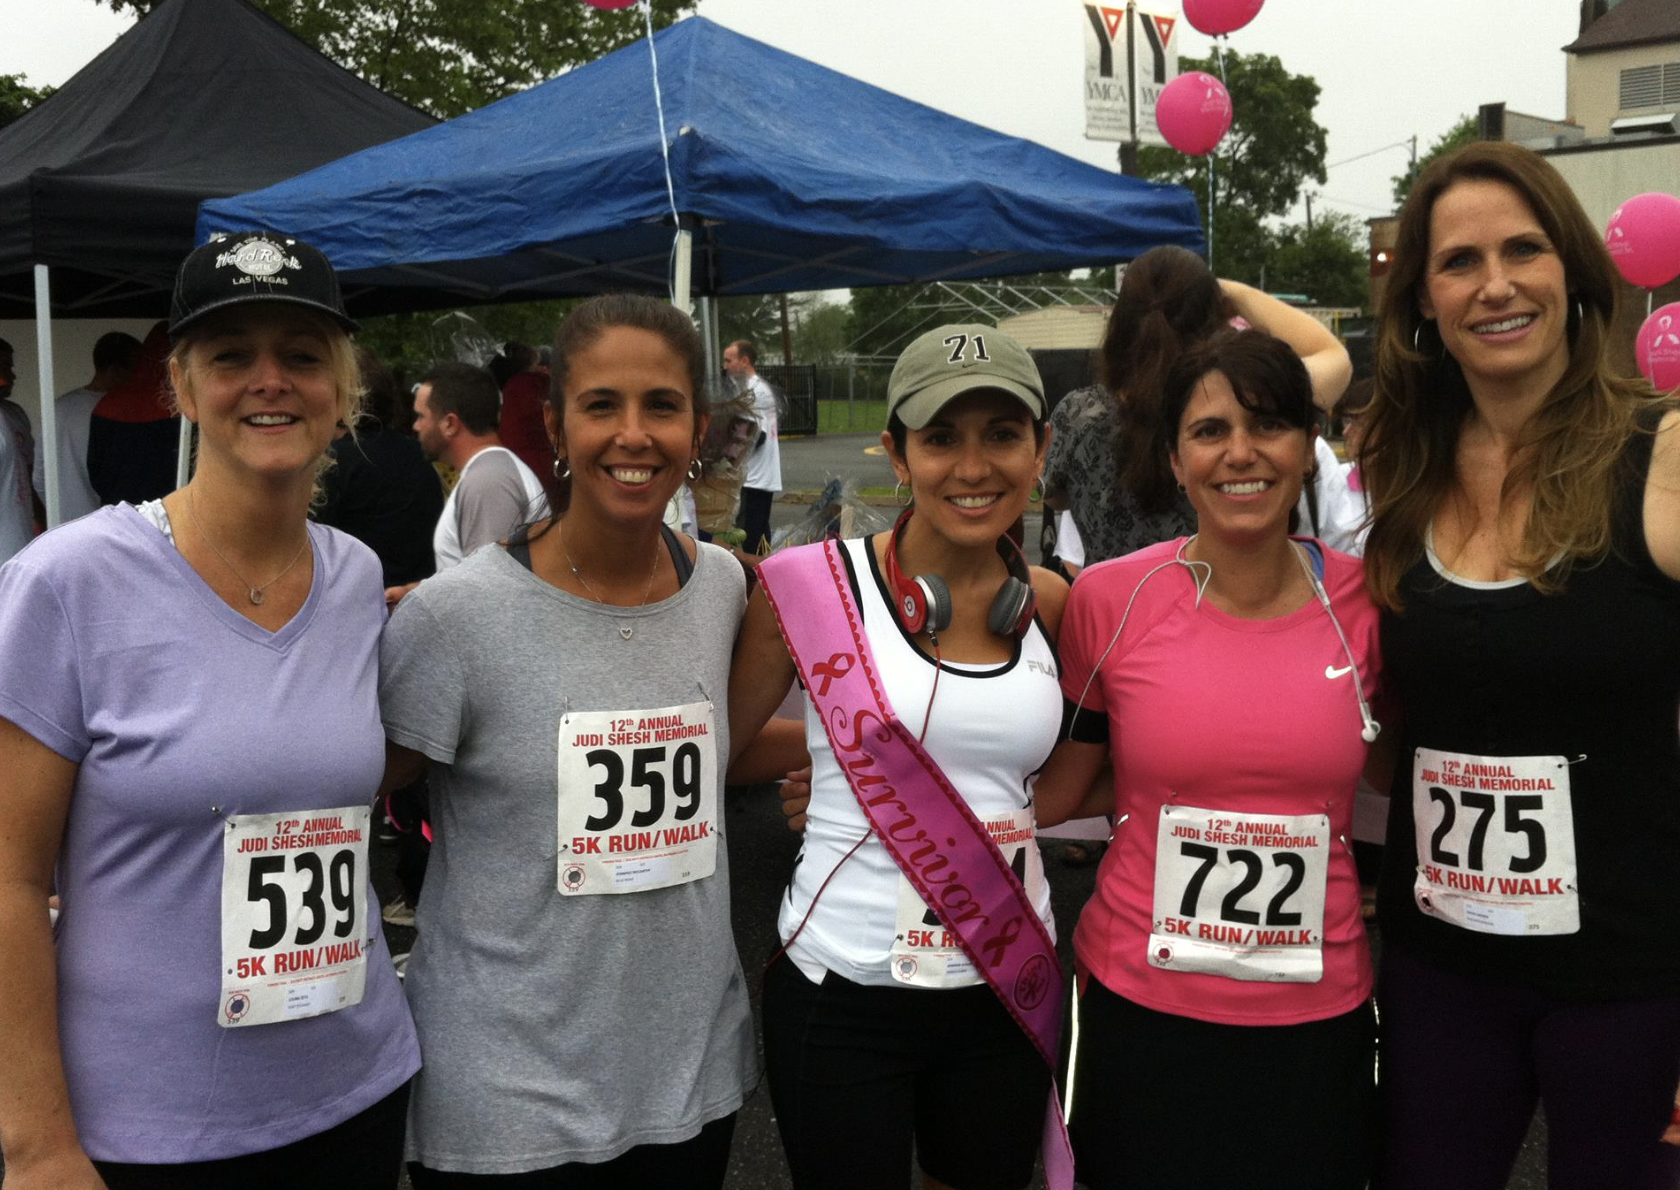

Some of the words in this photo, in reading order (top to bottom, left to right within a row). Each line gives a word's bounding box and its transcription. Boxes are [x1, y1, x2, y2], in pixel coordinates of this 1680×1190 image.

[1086, 81, 1127, 103] YMCA
[215, 249, 257, 269] Hard
[260, 248, 302, 270] Rock
[232, 276, 251, 285] LAS
[254, 275, 289, 285] VEGAS
[943, 333, 991, 364] 71
[1027, 660, 1055, 678] FILA
[610, 718, 634, 732] 12th
[638, 715, 684, 731] ANNUAL
[572, 734, 604, 747] JUDI
[608, 731, 651, 745] SHESH
[655, 723, 708, 743] MEMORIAL
[1421, 769, 1439, 783] JUDI
[1442, 773, 1475, 789] SHESH
[1479, 778, 1556, 791] MEMORIAL
[1442, 760, 1461, 773] 12th
[1464, 763, 1515, 778] ANNUAL
[584, 742, 701, 831] 359
[276, 819, 299, 834] 12th
[302, 817, 343, 833] ANNUAL
[831, 706, 990, 929] Survivor
[1207, 819, 1231, 831] 12th
[1235, 822, 1288, 836] ANNUAL
[1171, 826, 1199, 839] JUDI
[1204, 831, 1248, 845] SHESH
[1252, 836, 1318, 848] MEMORIAL
[1429, 787, 1547, 873] 275
[237, 837, 268, 853] JUDI
[271, 832, 314, 850] SHESH
[572, 836, 601, 855] 5K
[1180, 841, 1305, 926] 722
[1425, 865, 1443, 885] 5K
[247, 849, 355, 949] 539
[1165, 917, 1191, 936] 5K
[907, 930, 934, 947] 5K
[237, 955, 266, 979] 5K
